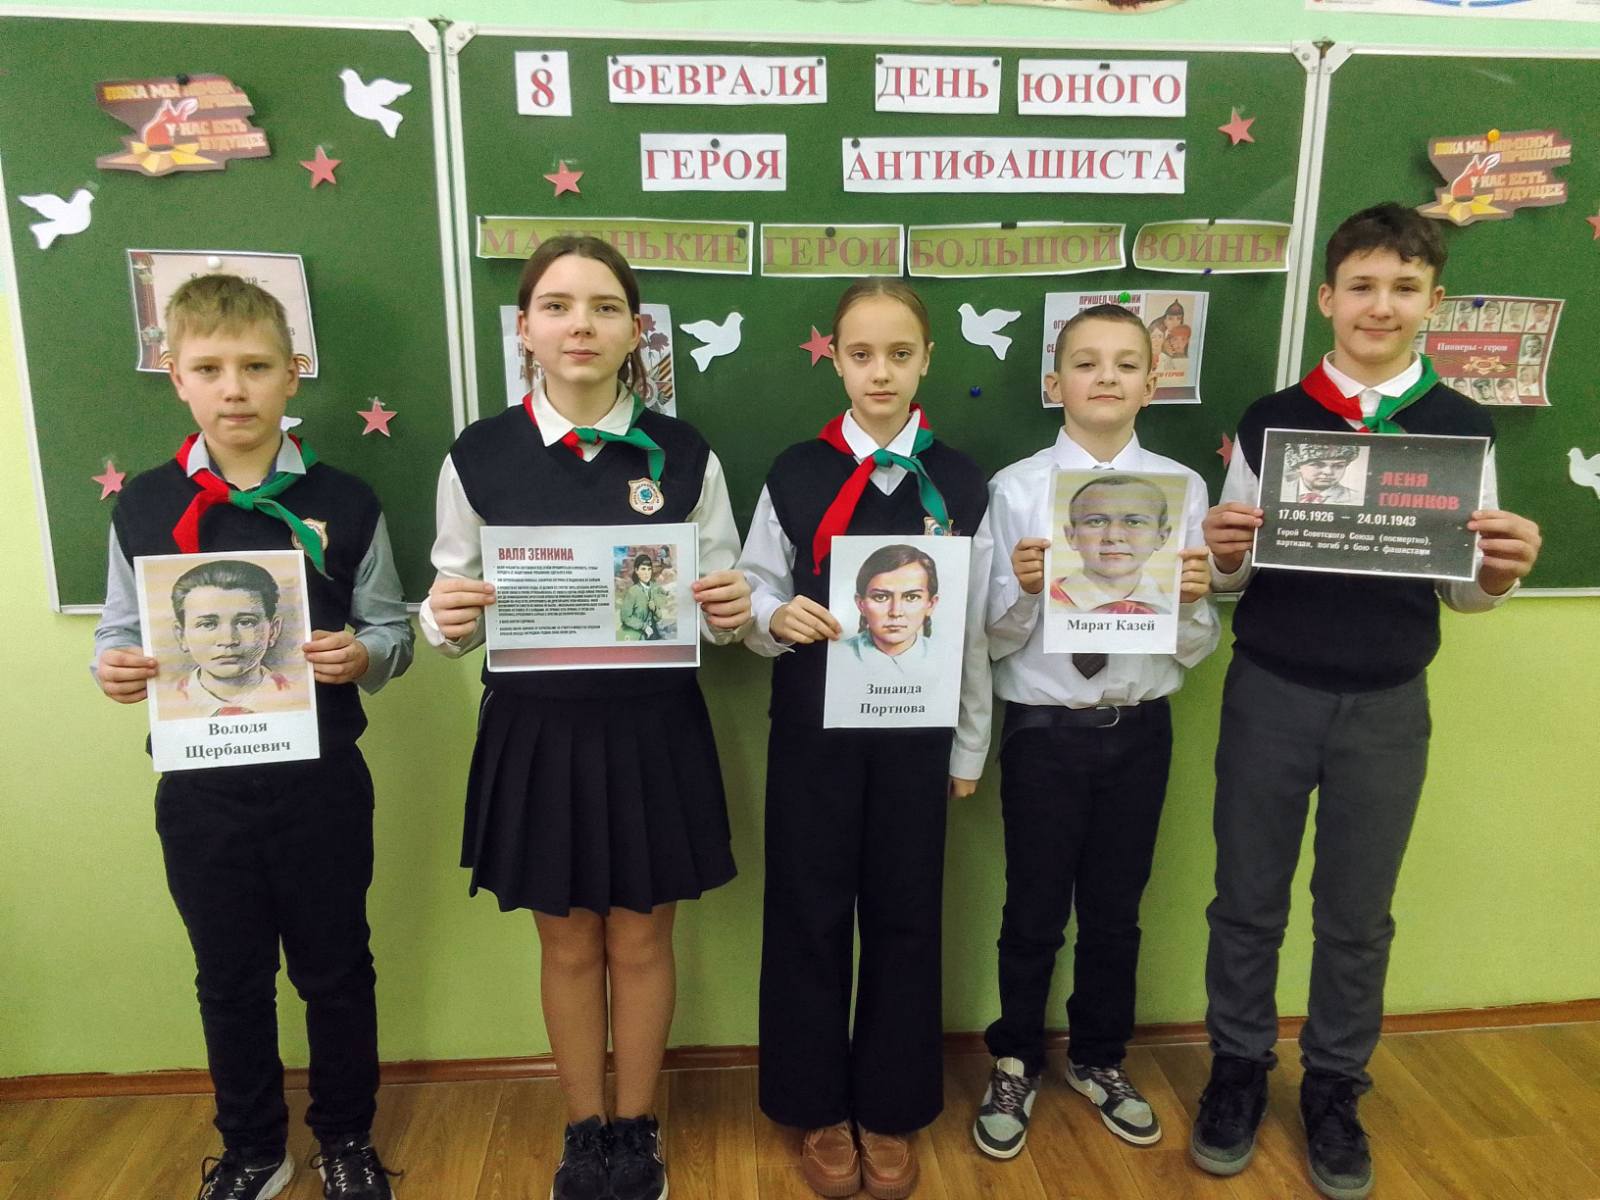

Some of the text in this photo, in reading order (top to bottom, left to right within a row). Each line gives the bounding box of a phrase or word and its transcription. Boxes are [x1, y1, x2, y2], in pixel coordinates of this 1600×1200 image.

[530, 64, 1182, 108] 8 ФЕВРАЛЯ ДЕНЬ ЮНОГО
[644, 149, 1179, 181] ГЕРОЯ АНТИФАШИСТА
[482, 222, 1288, 268] МАНЬКИЕ ГЕРОИ БОЛЬШОЙ ВОЙНЫ
[1278, 509, 1335, 522] 17.06.1926
[1357, 513, 1417, 527] 24.01.1943
[1277, 528, 1299, 537] Герой
[498, 547, 575, 561] ВАЛЯ ЗЕНКИНА
[1067, 619, 1156, 633] Марат Казей
[866, 683, 922, 695] Зинаида
[859, 703, 926, 717] Портнова
[208, 721, 268, 736] Володя
[184, 741, 291, 760] Щербацевич
